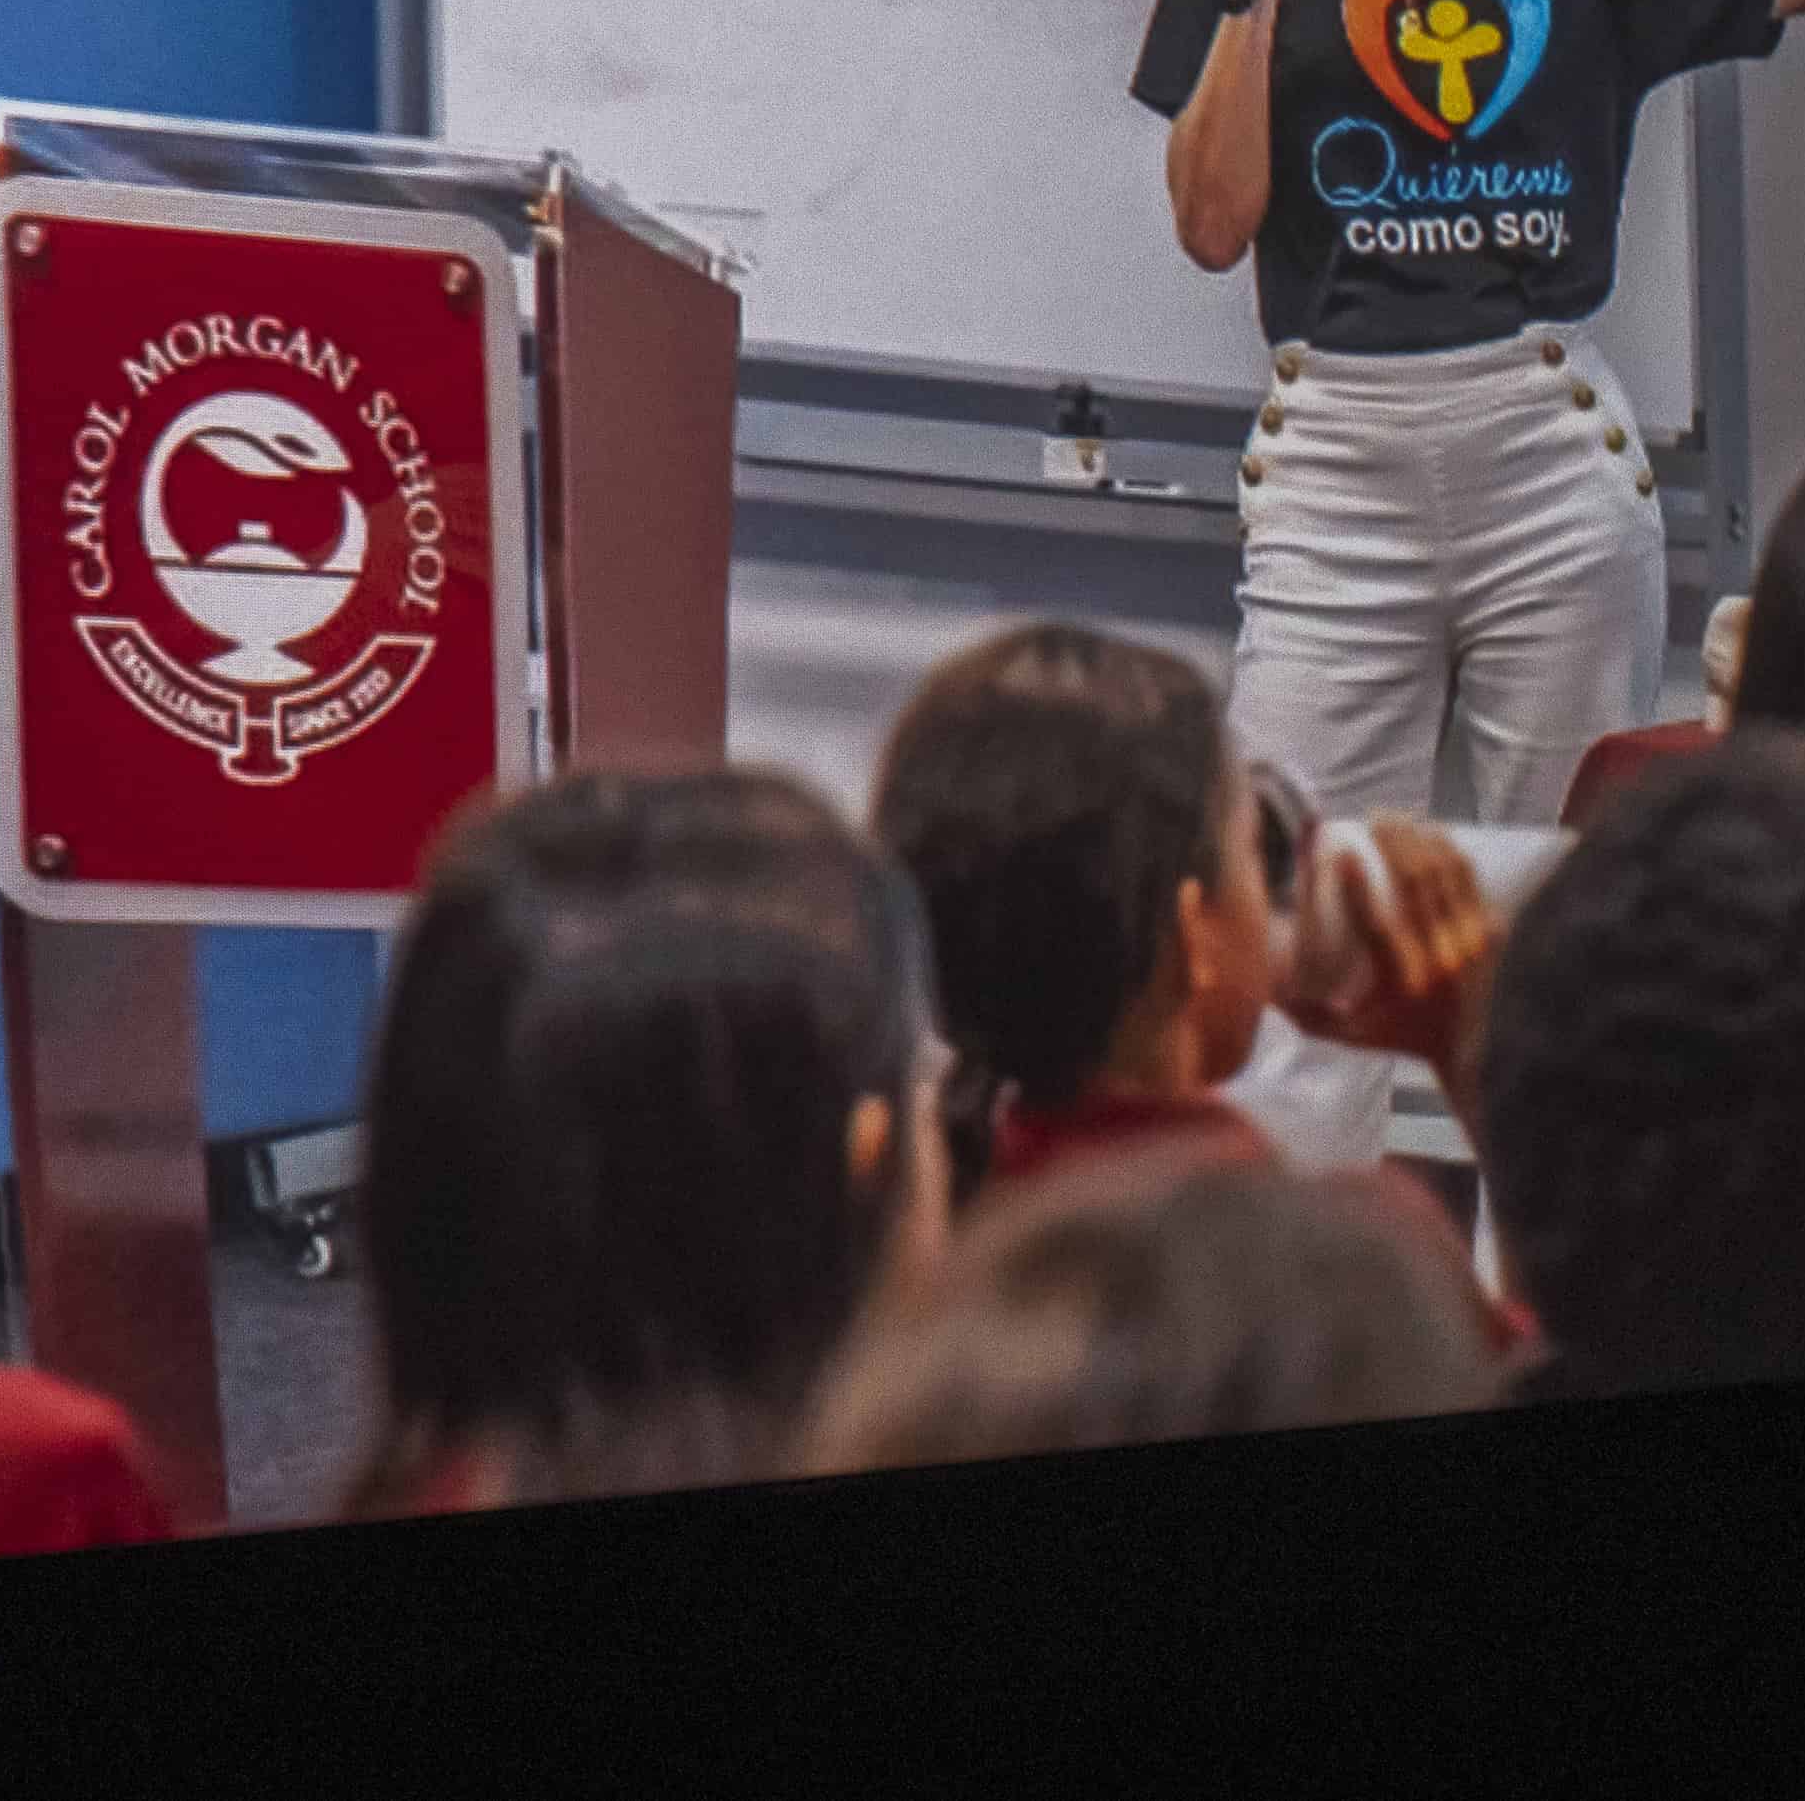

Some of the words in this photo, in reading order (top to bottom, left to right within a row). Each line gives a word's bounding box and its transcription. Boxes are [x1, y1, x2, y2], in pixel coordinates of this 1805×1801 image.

[1346, 213, 1484, 255] como
[63, 401, 131, 599] CAROL
[120, 313, 359, 395] MORGAN
[358, 390, 446, 616] SCHOOL
